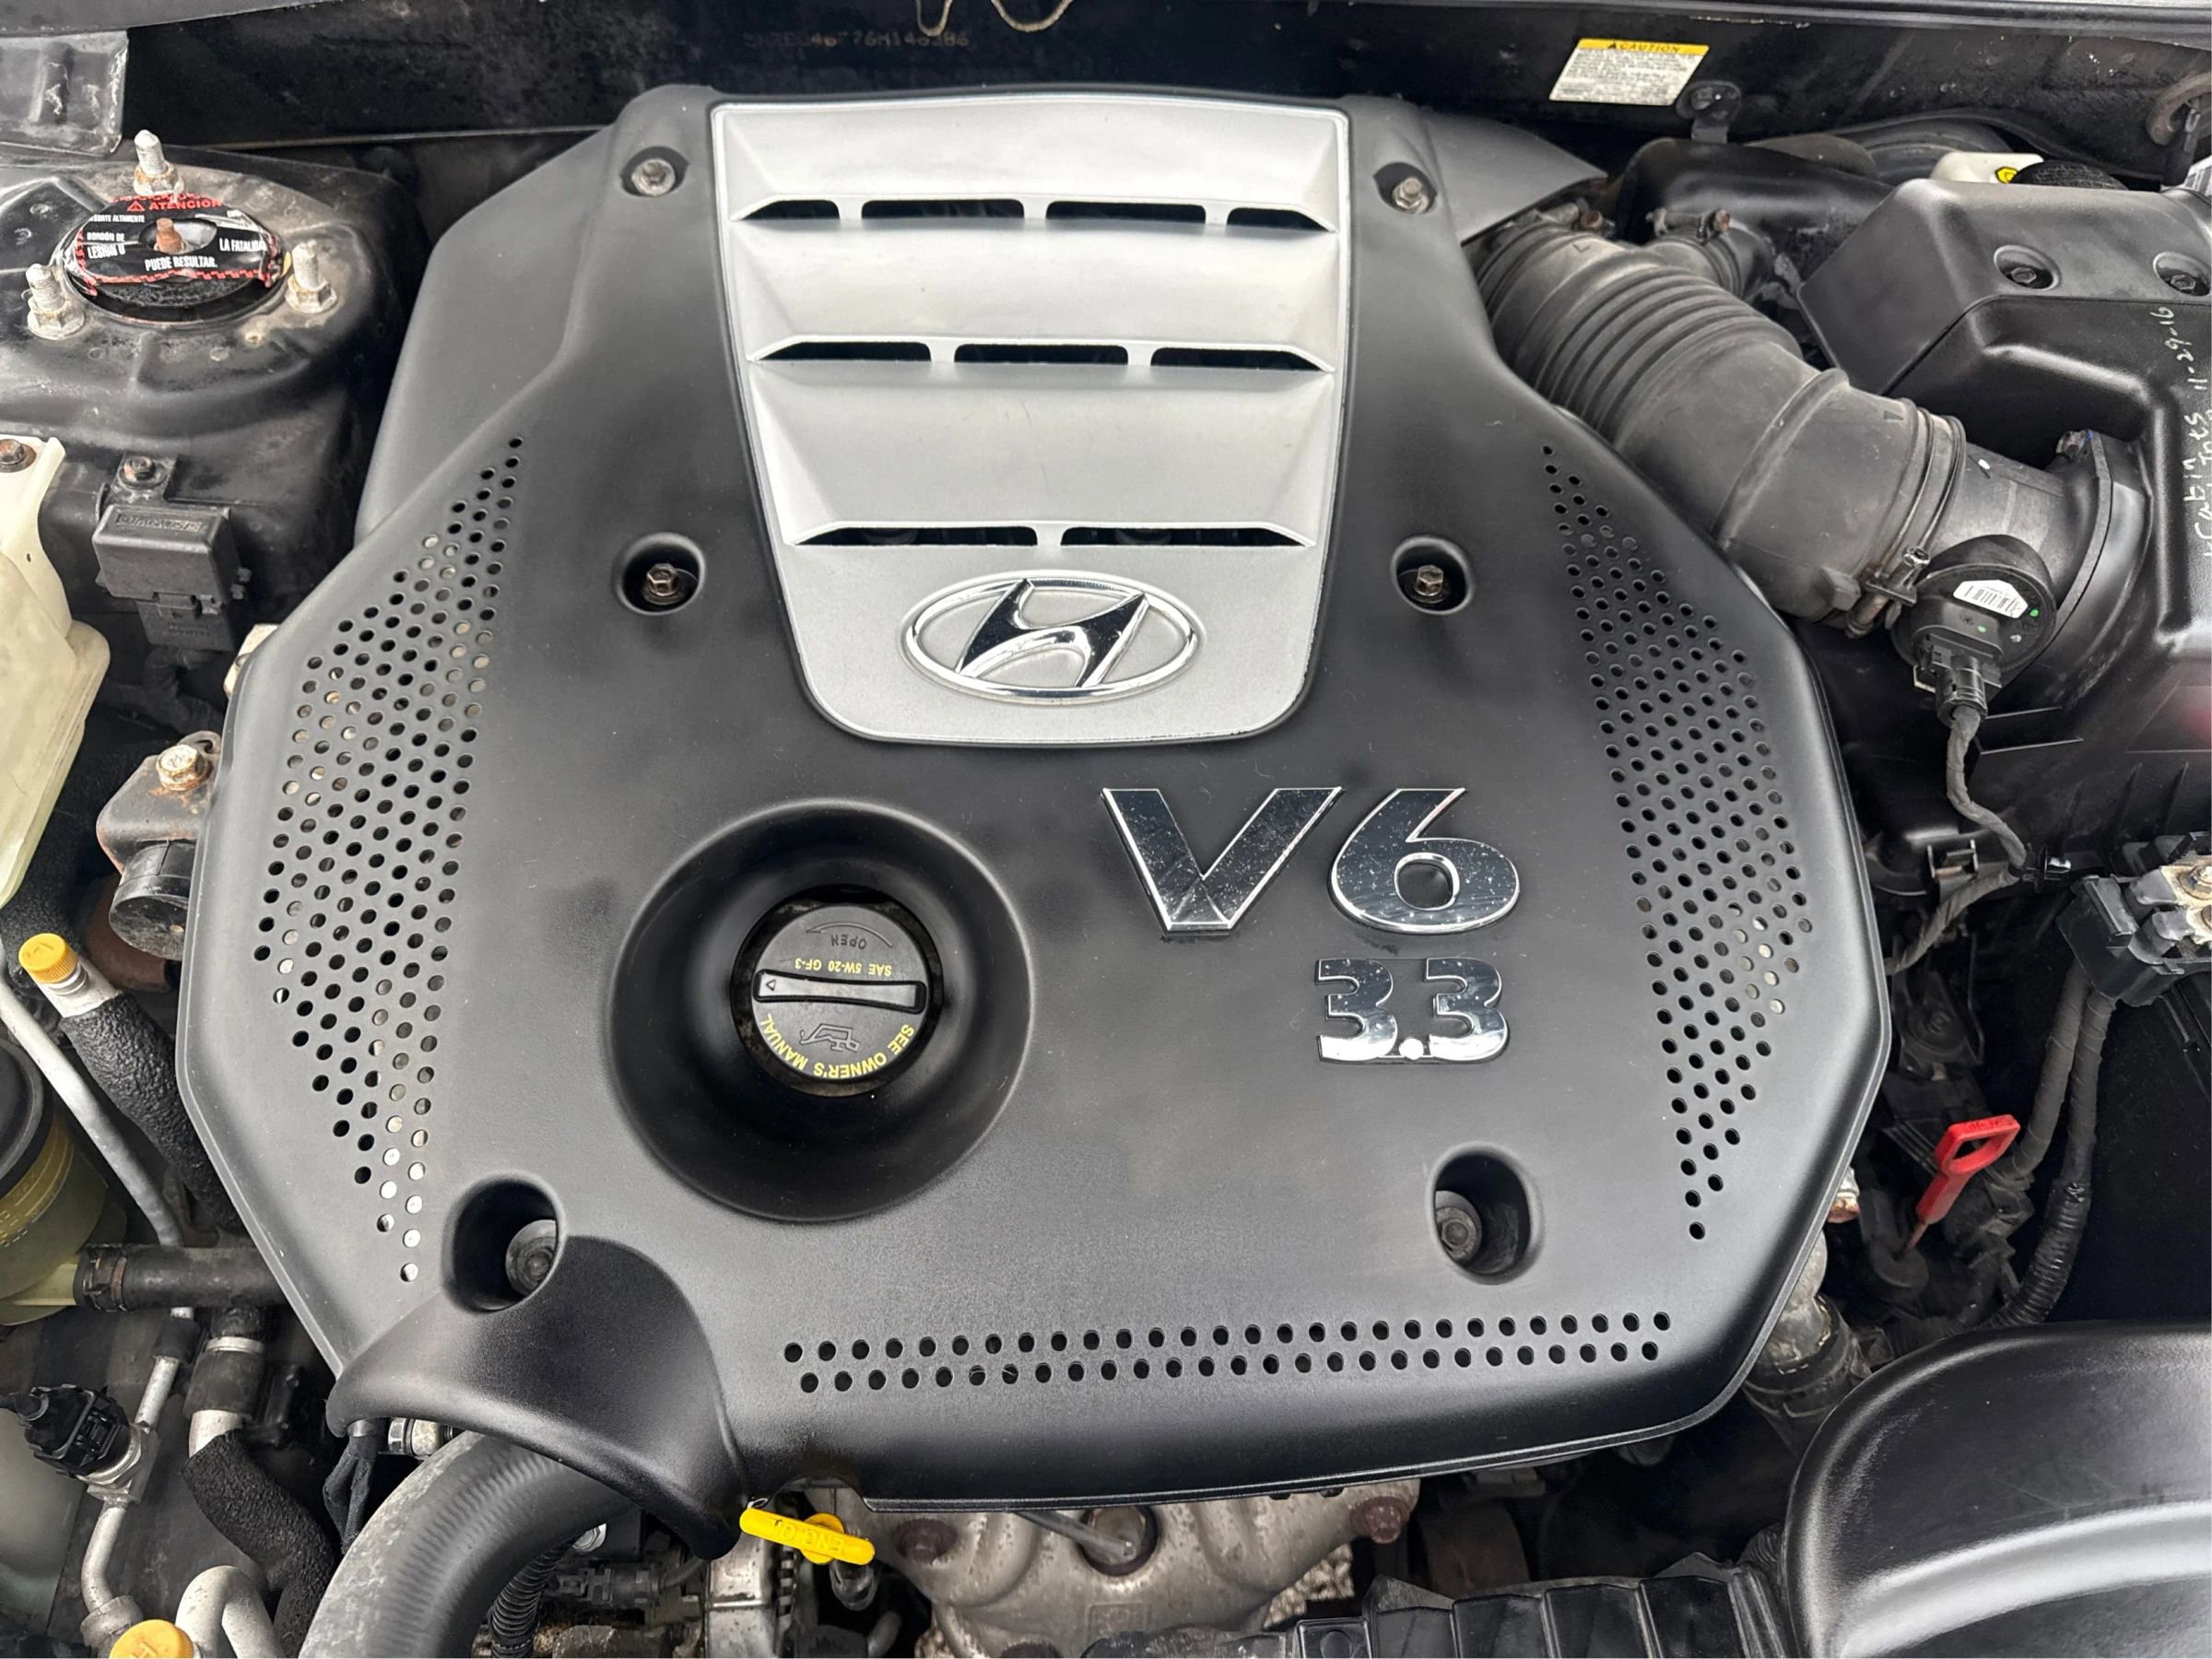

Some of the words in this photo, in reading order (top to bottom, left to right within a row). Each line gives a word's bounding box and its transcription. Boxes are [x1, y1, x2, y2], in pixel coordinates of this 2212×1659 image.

[1619, 42, 1681, 53] CAUTION
[219, 238, 230, 252] LA
[230, 239, 267, 253] FATALIDA
[145, 257, 172, 272] PUEDE
[1100, 786, 1521, 935] V6
[830, 934, 867, 950] OPEN
[794, 958, 823, 971] GF-3
[828, 959, 863, 974] 5W-20
[868, 963, 893, 977] SAE
[1314, 957, 1511, 1065] 3.3
[759, 1013, 809, 1070] MANUAL
[887, 1024, 915, 1055] SEE
[813, 1053, 887, 1079] OWNER'S
